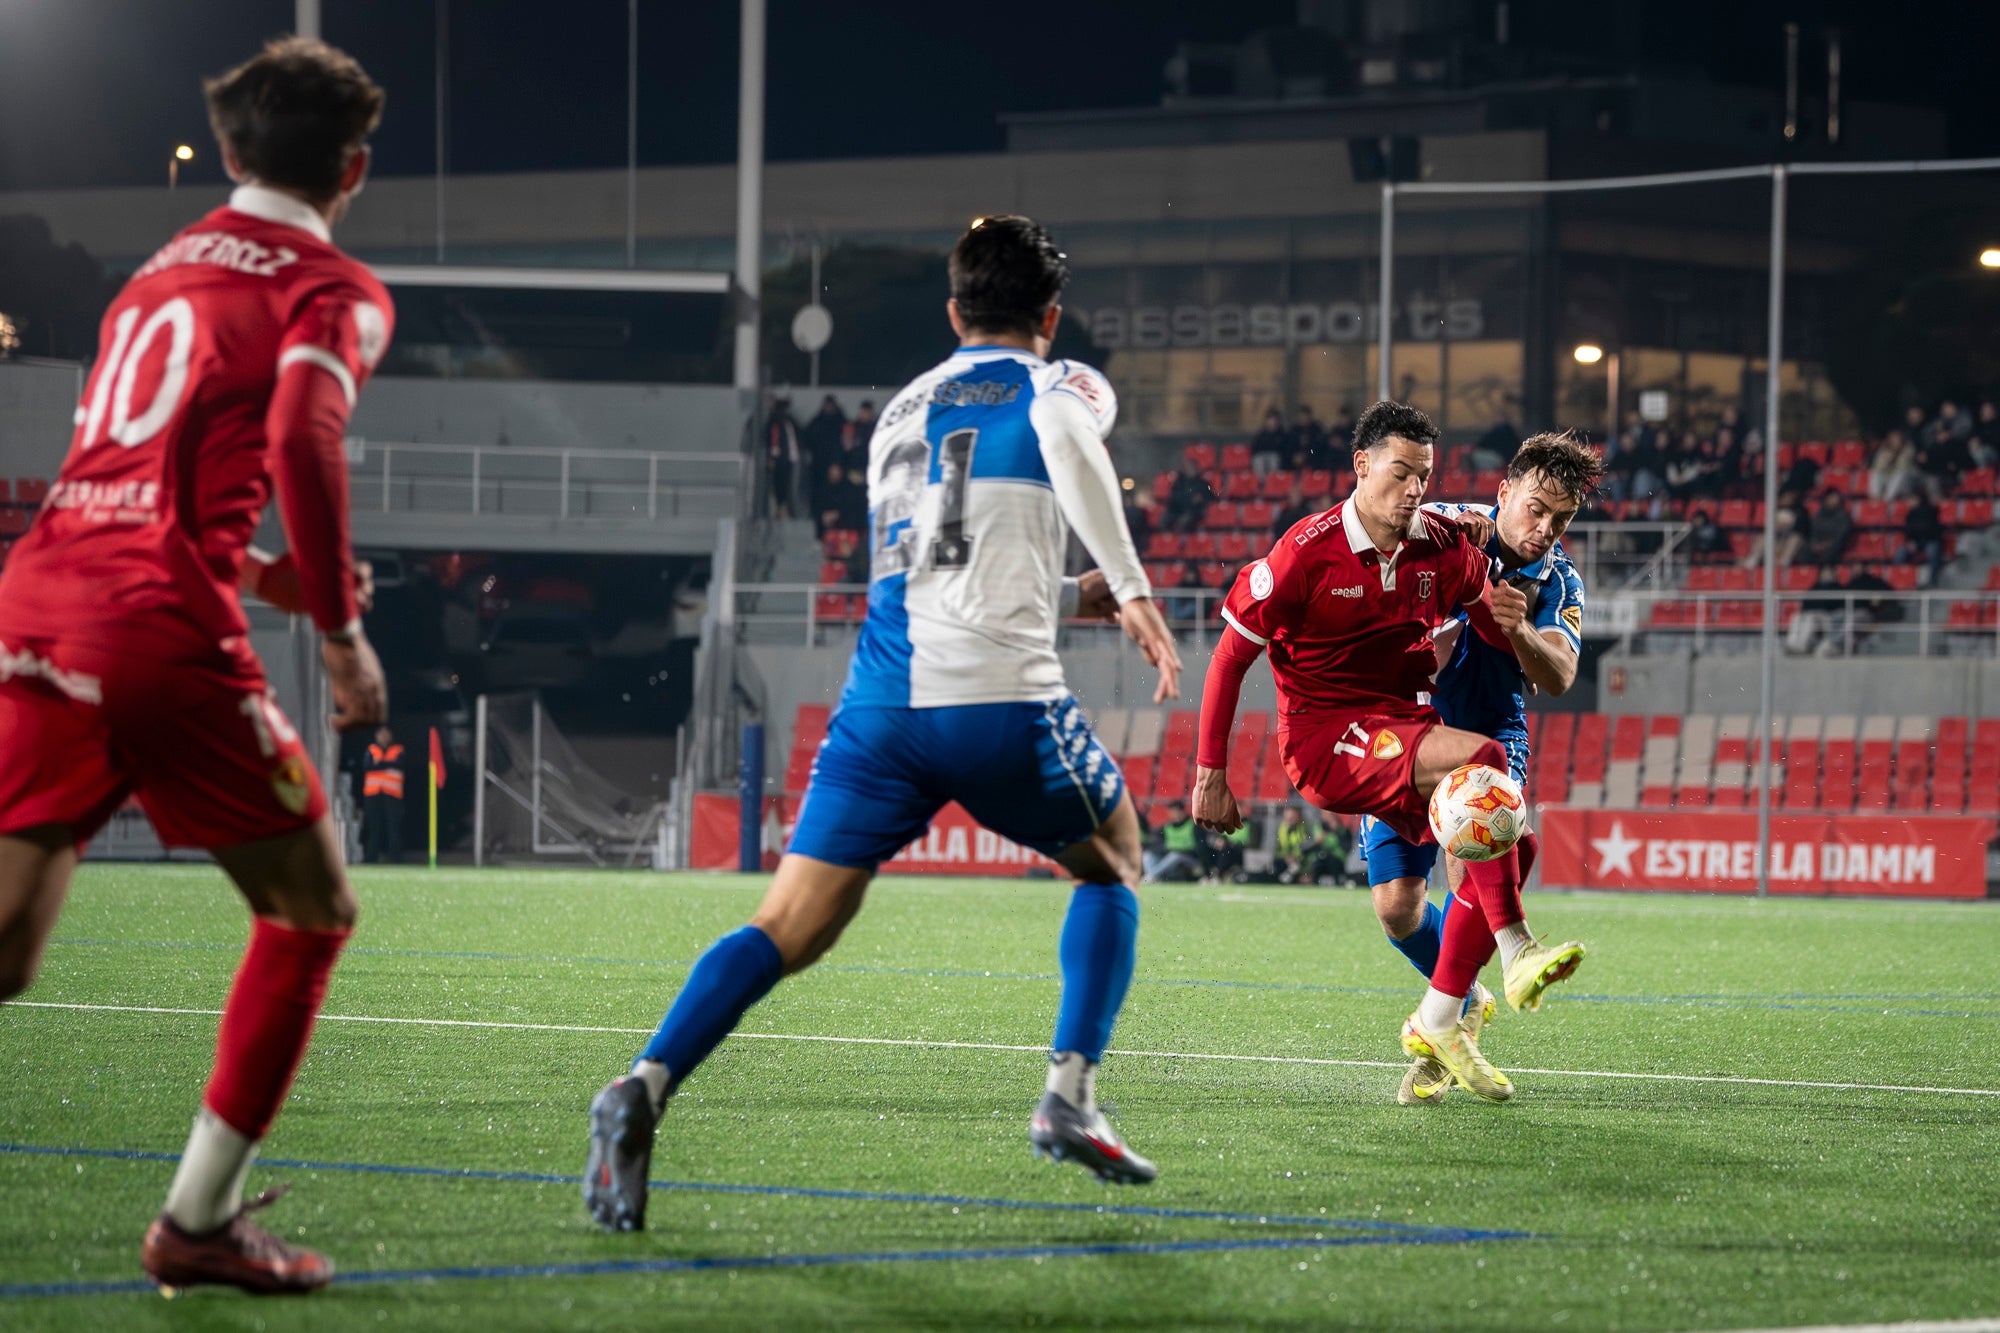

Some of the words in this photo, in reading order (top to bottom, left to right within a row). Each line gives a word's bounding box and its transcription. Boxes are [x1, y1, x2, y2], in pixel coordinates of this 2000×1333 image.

[1072, 291, 1484, 351] assasports
[75, 297, 195, 450] 10
[874, 427, 979, 579] 21
[1333, 721, 1370, 759] 17
[1821, 842, 1936, 884] DAMM
